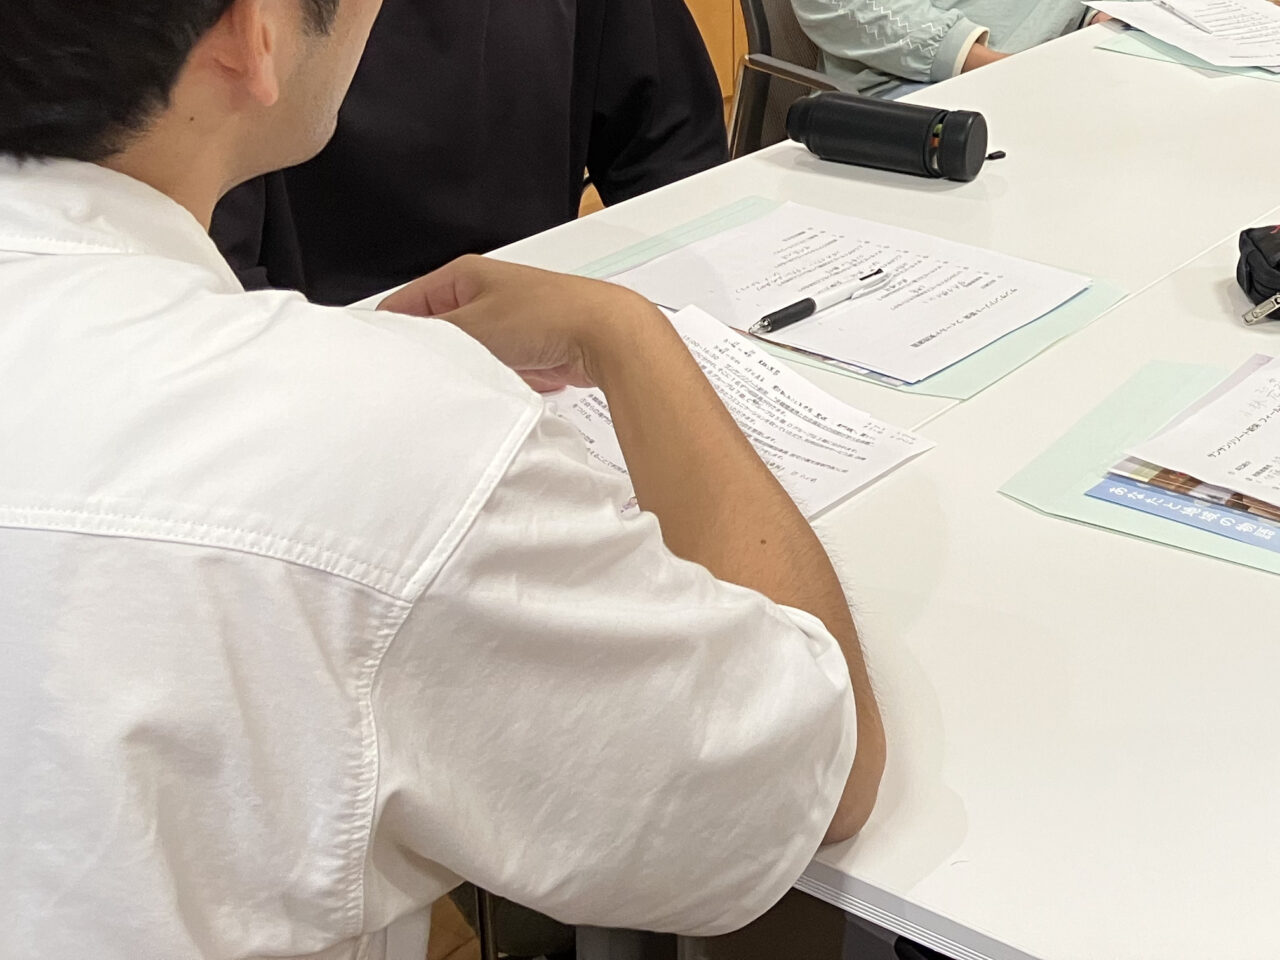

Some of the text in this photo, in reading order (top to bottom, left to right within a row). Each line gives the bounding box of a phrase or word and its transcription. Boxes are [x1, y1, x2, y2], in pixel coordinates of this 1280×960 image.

[1109, 487, 1276, 540] あなたと地域の物語
